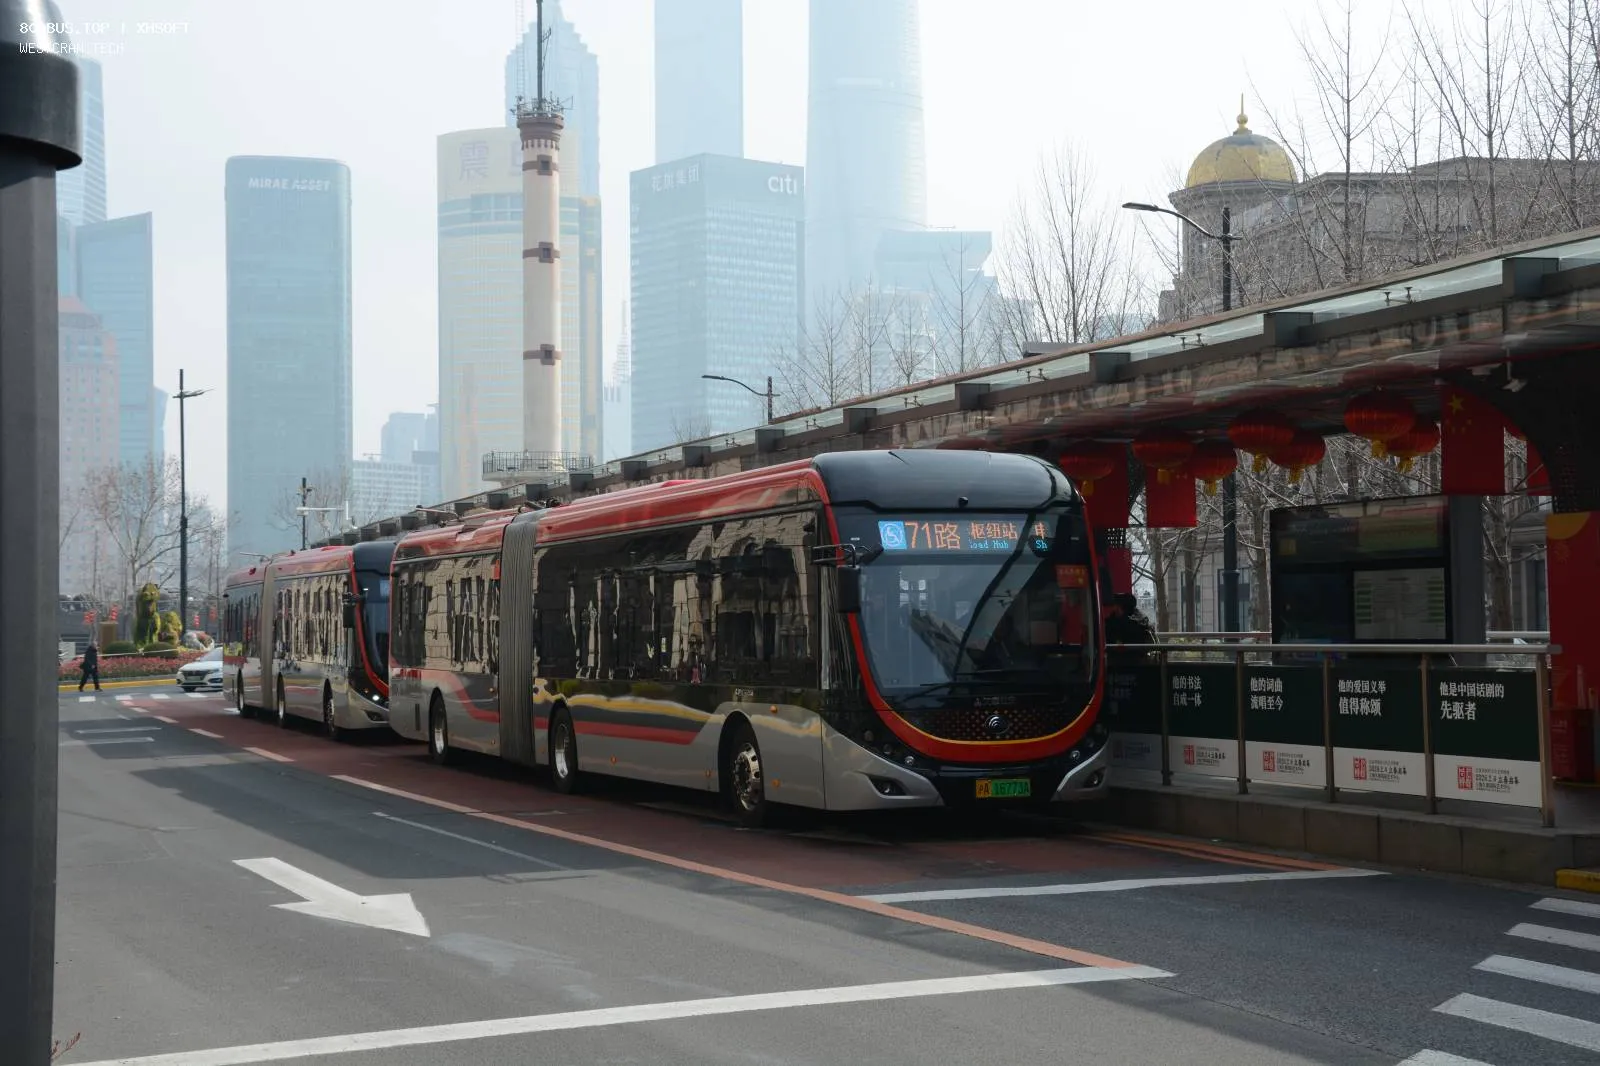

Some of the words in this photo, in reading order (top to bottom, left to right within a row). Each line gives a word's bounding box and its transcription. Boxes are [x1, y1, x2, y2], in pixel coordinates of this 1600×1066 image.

[248, 177, 289, 190] MIRAE
[292, 179, 331, 191] ASSET
[651, 163, 700, 194] 花旗集团
[767, 174, 798, 195] citi
[905, 521, 961, 549] 71路
[970, 522, 1018, 540] 枢纽站
[1172, 675, 1202, 691] 他的书法
[1250, 677, 1283, 693] 他的词曲
[1338, 679, 1387, 695] 他的爱国义举
[1439, 681, 1504, 699] 他是中国话剧的
[1173, 692, 1202, 708] 自成一体
[1338, 697, 1382, 716] 值得称颂
[1440, 700, 1477, 721] 先驱者
